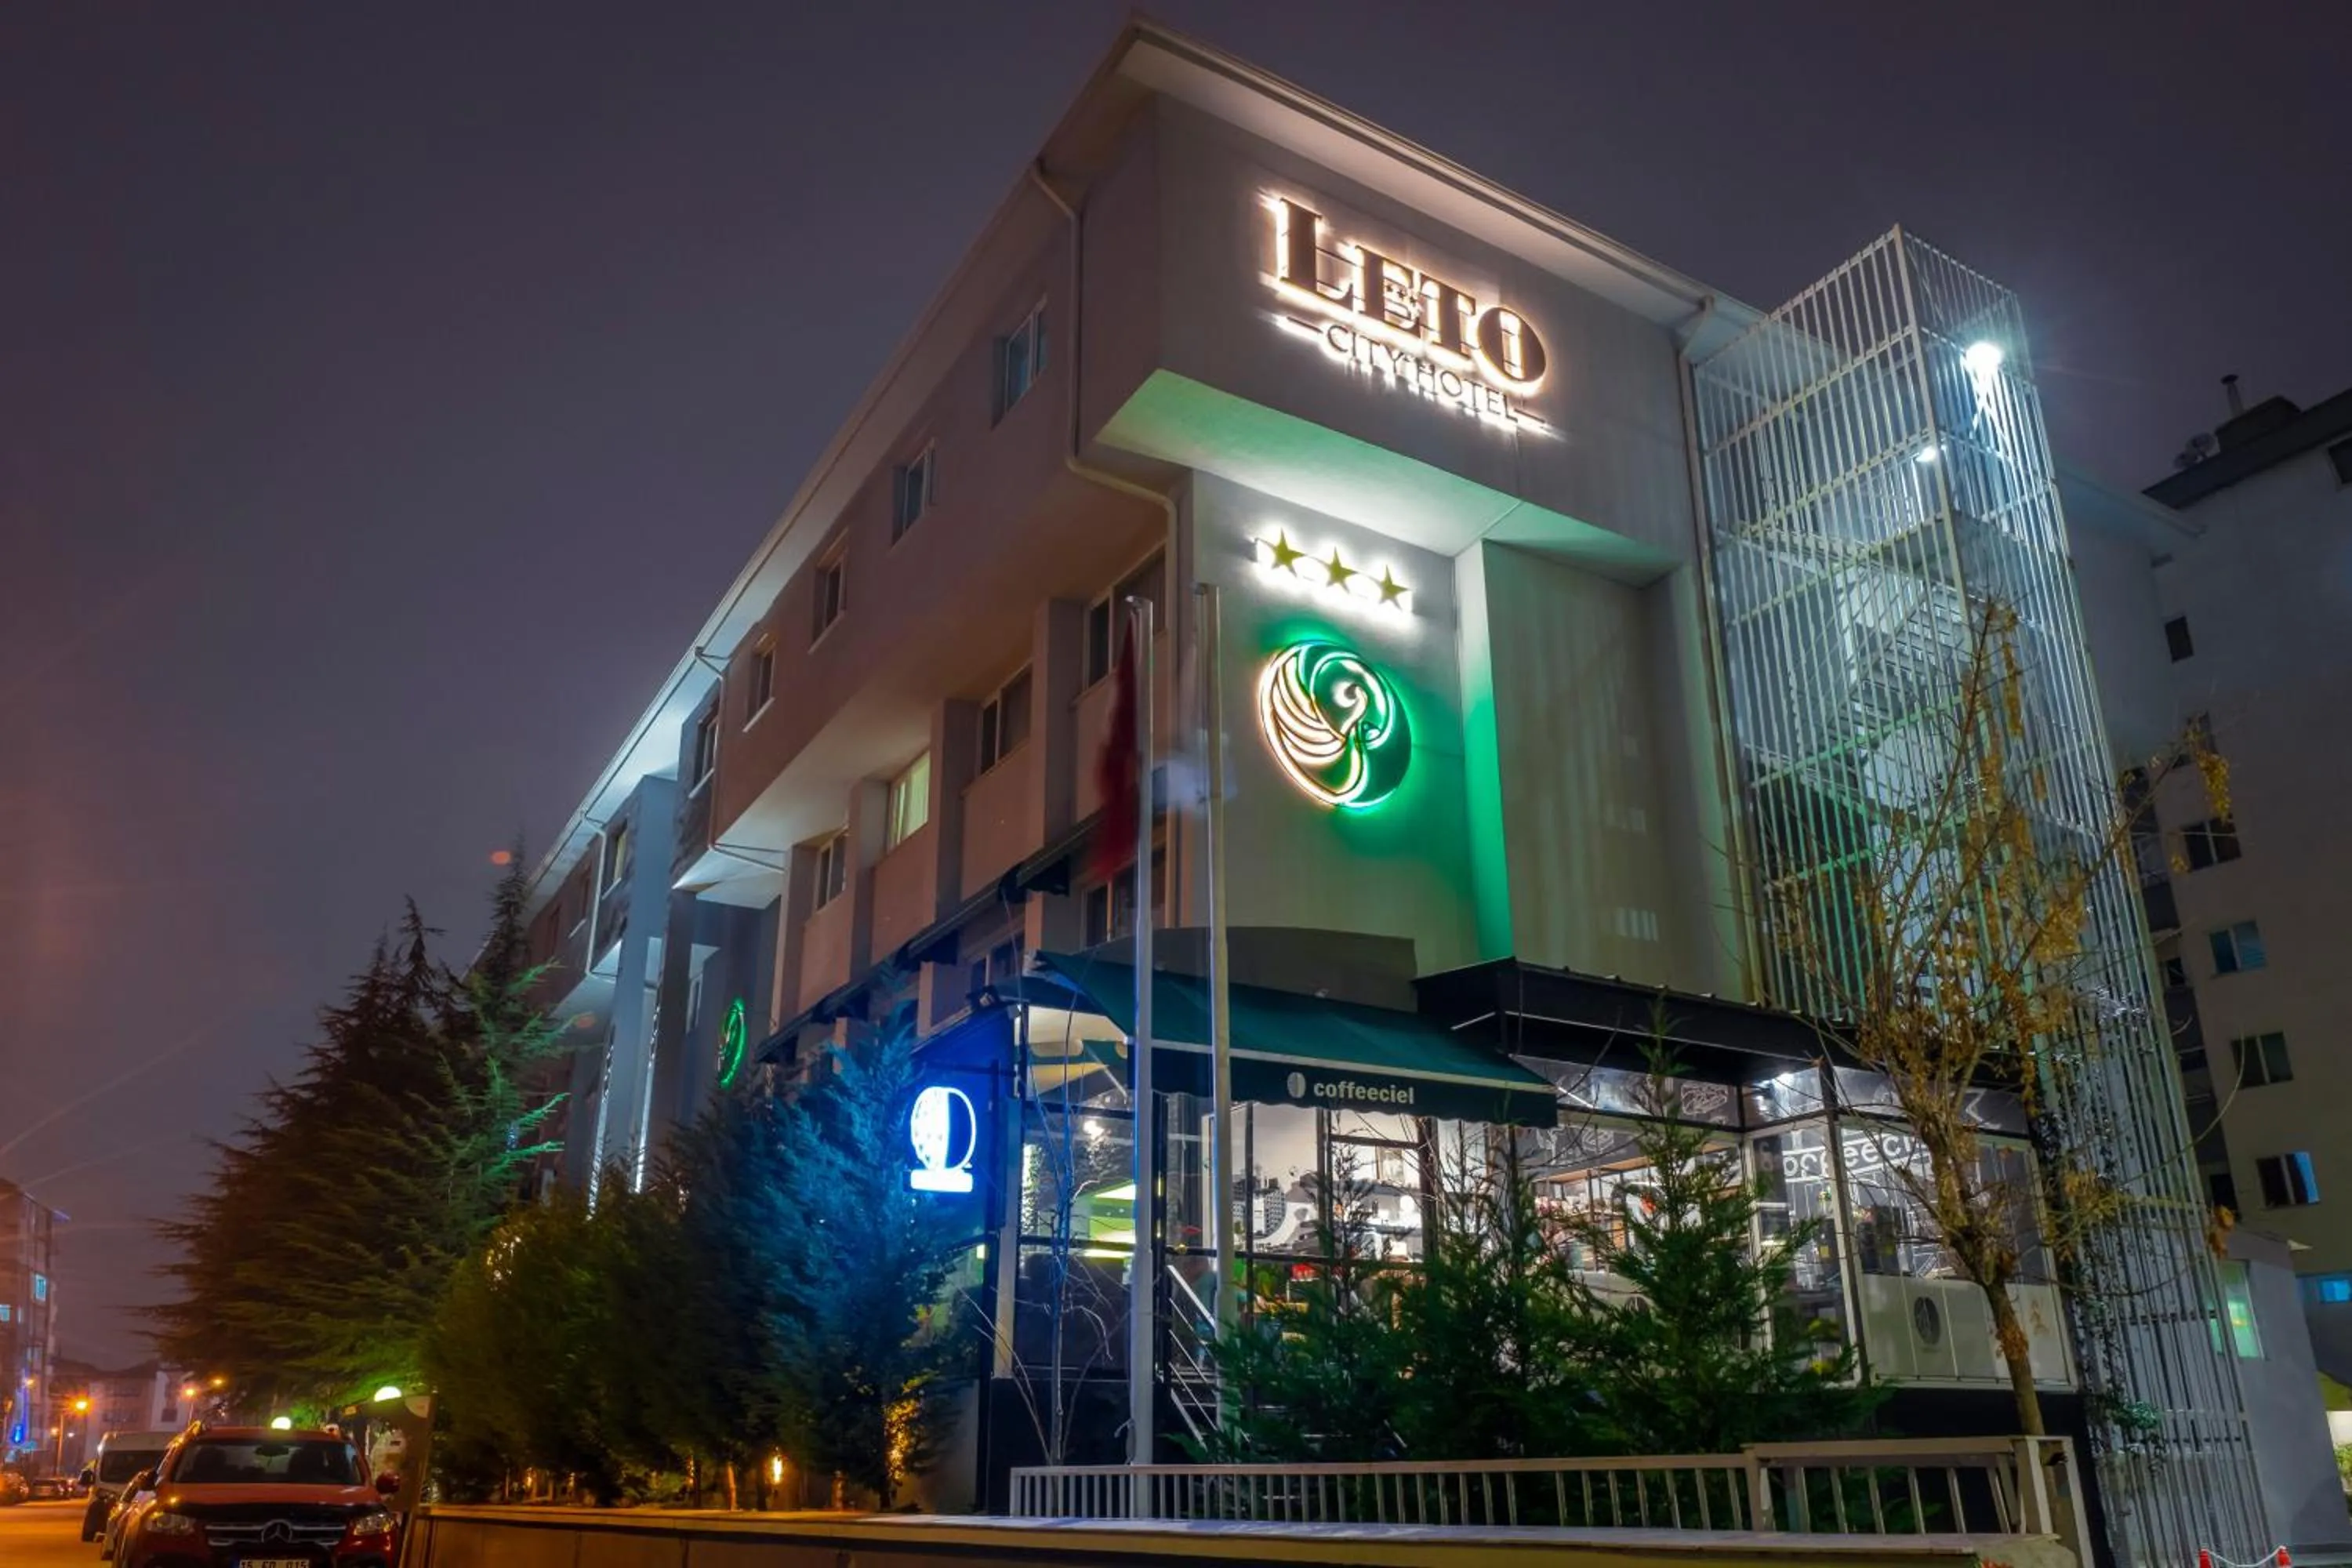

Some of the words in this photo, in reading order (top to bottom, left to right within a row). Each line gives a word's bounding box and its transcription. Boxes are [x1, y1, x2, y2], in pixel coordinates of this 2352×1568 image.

[1278, 198, 1546, 383] LETO
[1327, 324, 1403, 374] CITY
[1415, 357, 1519, 423] HOTEL
[1313, 1081, 1414, 1104] coffeeciel
